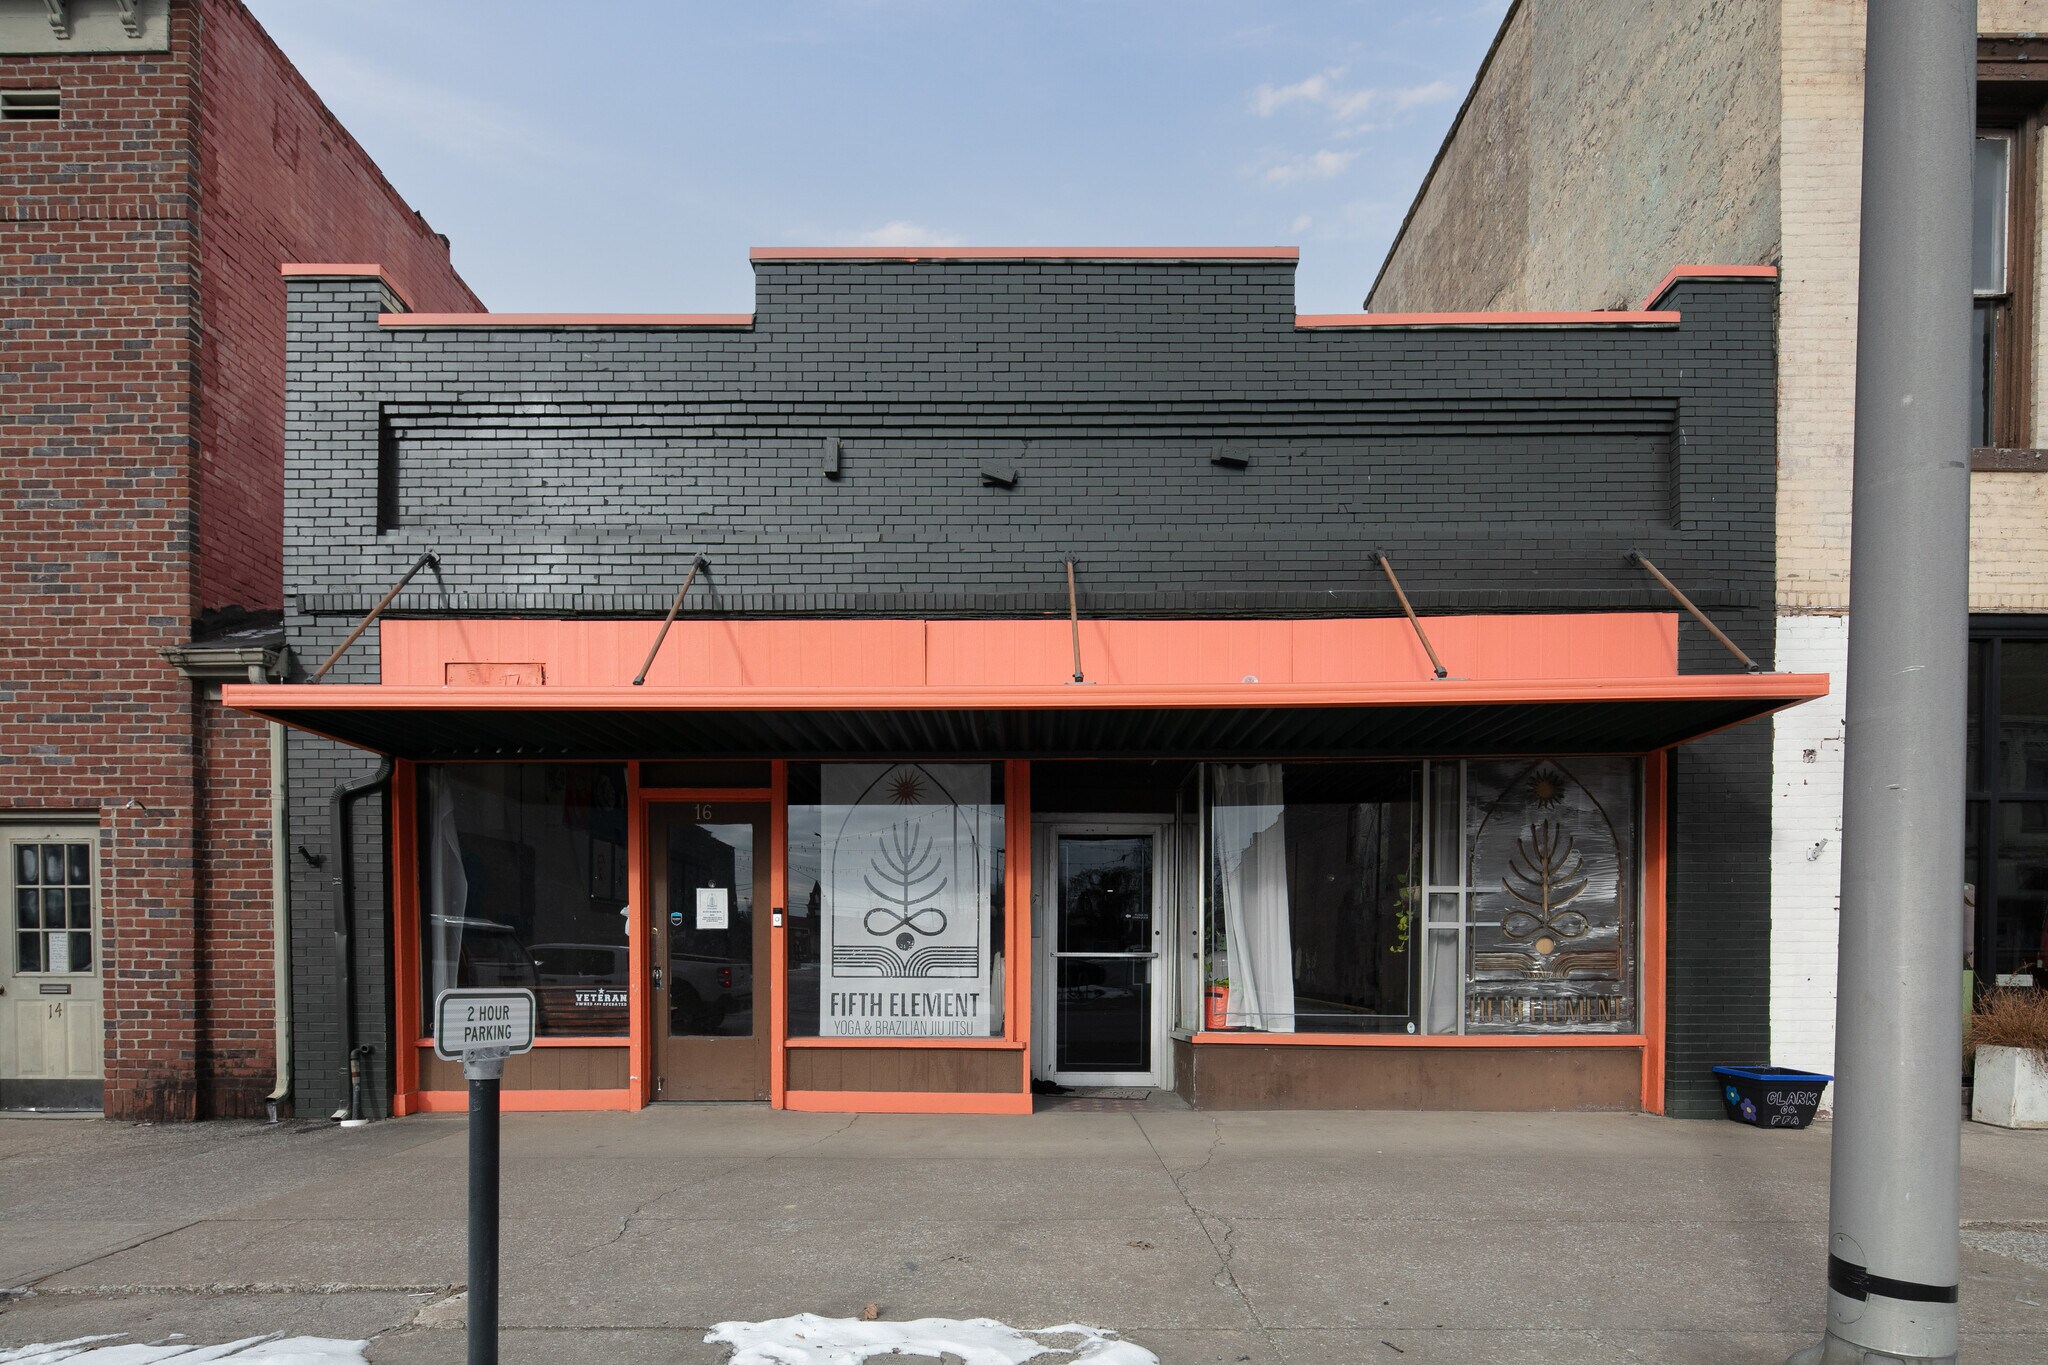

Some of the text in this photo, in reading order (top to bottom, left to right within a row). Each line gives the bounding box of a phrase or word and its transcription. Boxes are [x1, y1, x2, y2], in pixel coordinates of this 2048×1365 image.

[695, 804, 712, 820] 16
[575, 993, 628, 1002] VETERAN
[830, 992, 980, 1017] FIFTH ELEMENT
[48, 1002, 63, 1019] 14
[467, 1005, 510, 1022] 2 HOUR
[1529, 995, 1623, 1023] ELEMENT
[464, 1024, 512, 1043] PARKING
[834, 1020, 974, 1036] YOGA & BRAZILIAN JIU JITSU
[1766, 1091, 1818, 1106] CLARK
[1780, 1105, 1797, 1115] CO.
[1770, 1115, 1800, 1126] FFA
